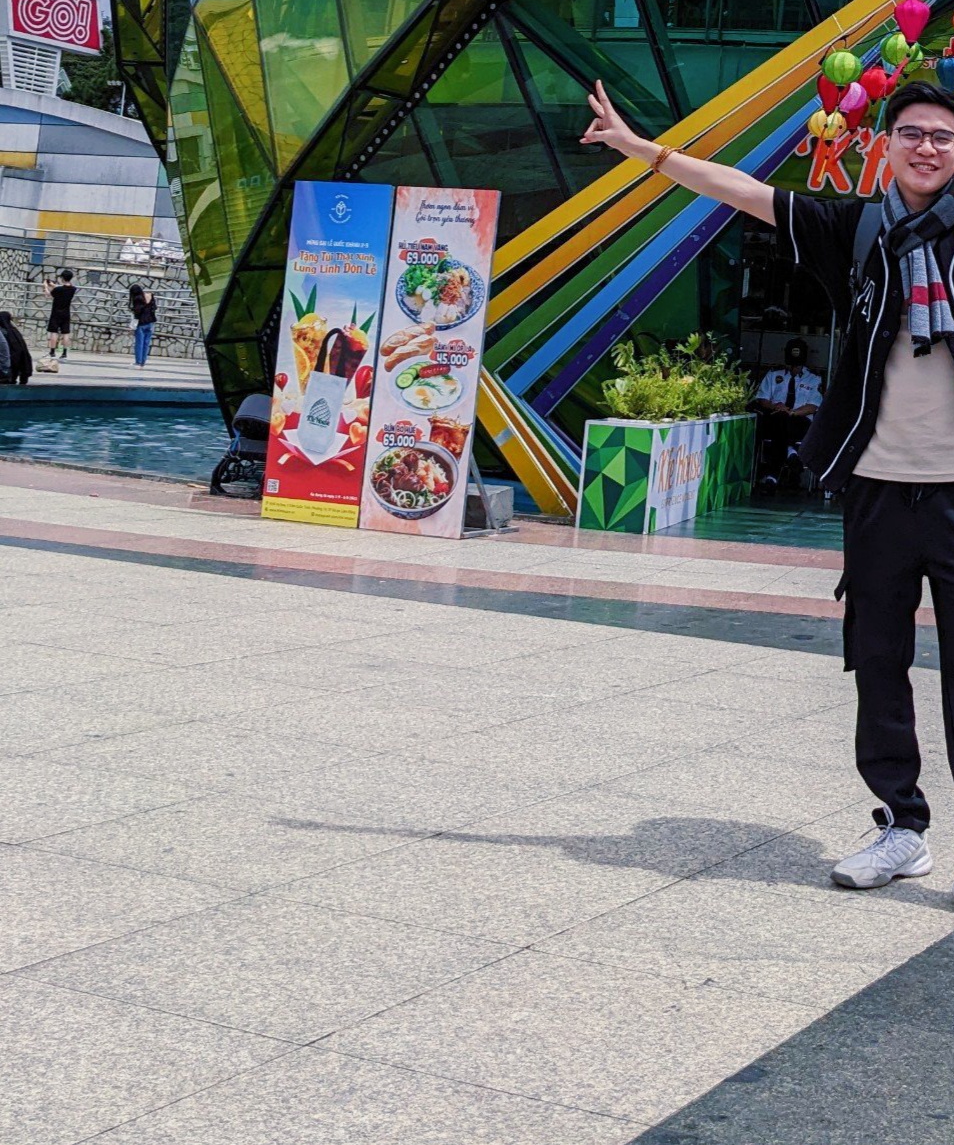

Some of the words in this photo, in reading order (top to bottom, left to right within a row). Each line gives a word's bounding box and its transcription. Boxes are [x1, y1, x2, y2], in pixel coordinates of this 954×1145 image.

[406, 251, 440, 265] 69.000
[293, 262, 317, 275] Lung
[320, 263, 341, 274] Linh
[436, 352, 468, 366] 45.000
[383, 433, 416, 447] 69.000
